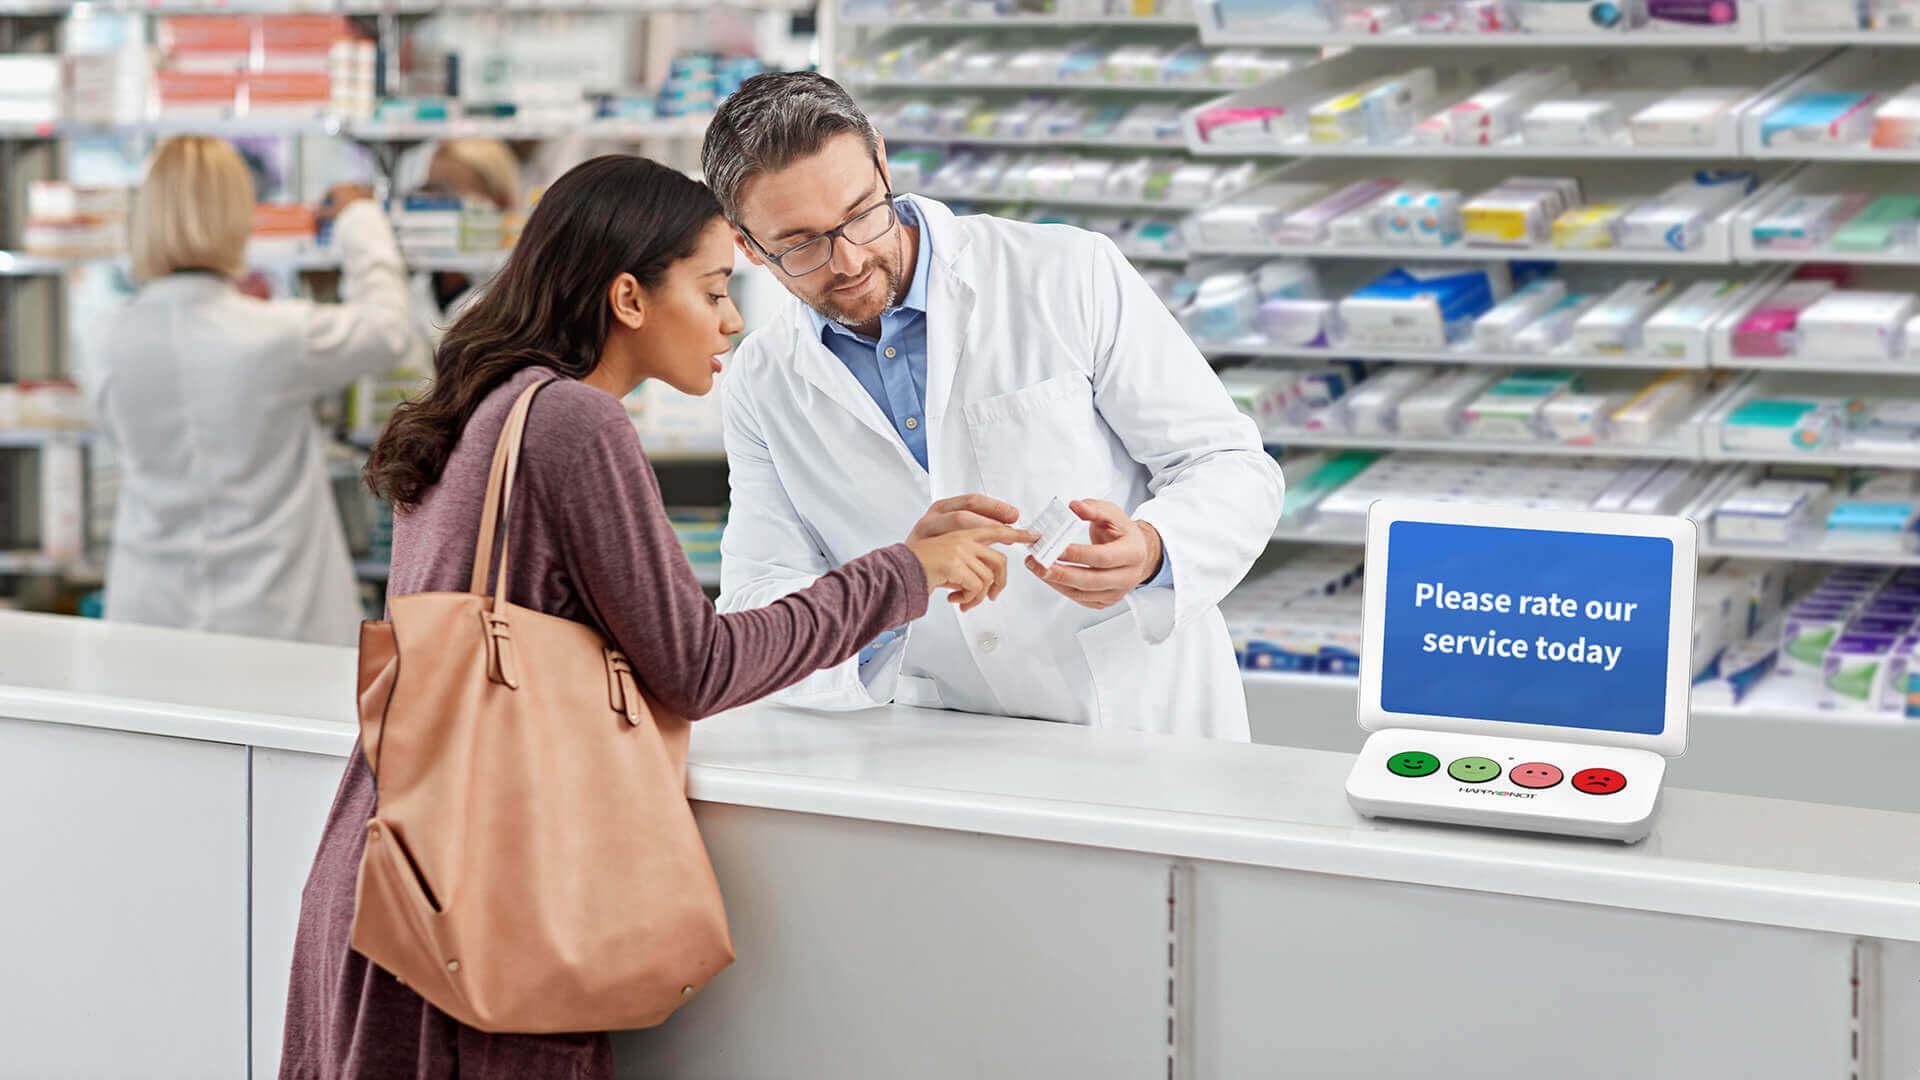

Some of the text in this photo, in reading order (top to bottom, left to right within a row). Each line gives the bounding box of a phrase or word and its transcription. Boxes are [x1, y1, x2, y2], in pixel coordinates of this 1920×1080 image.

[1415, 582, 1638, 622] Please rate our
[1422, 629, 1622, 671] service today
